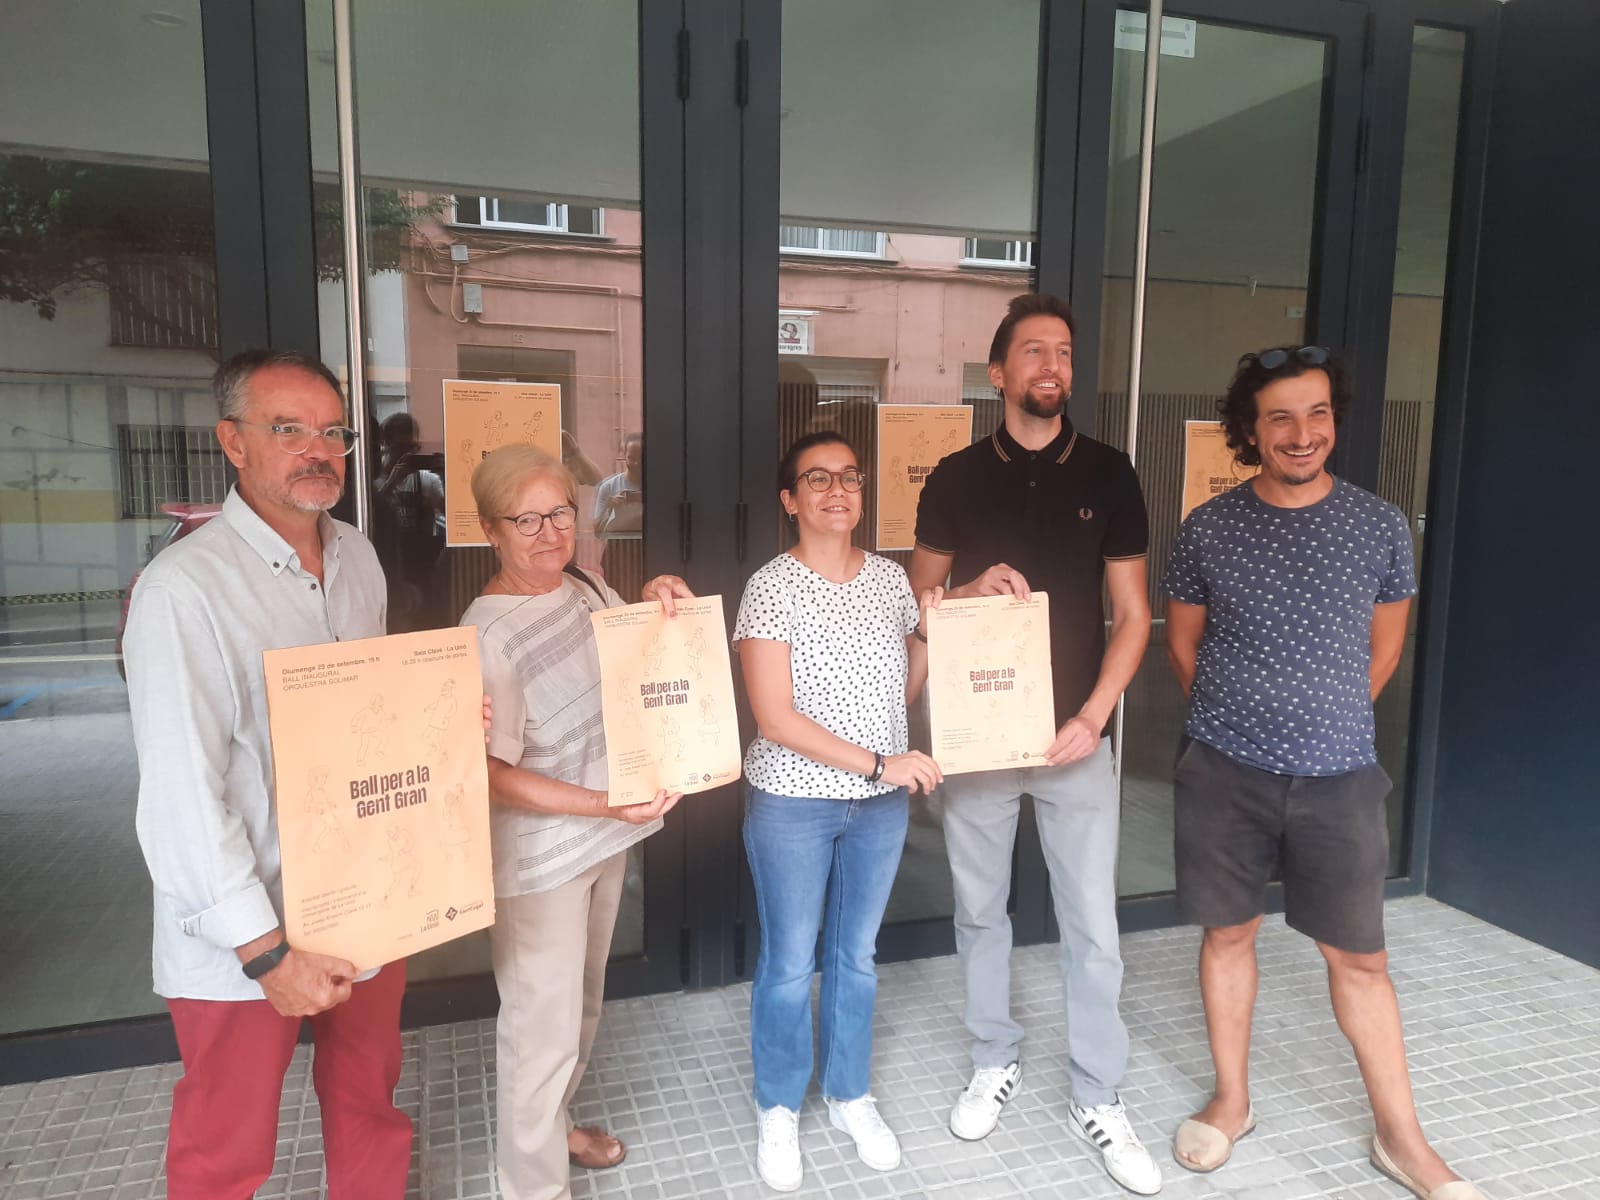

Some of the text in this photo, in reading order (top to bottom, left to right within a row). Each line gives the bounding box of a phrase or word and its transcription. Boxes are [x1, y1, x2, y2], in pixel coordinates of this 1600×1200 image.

[908, 465, 919, 474] Ball
[920, 466, 930, 475] per
[282, 665, 316, 675] Diumenge
[970, 667, 1015, 681] Ball per a la
[282, 671, 340, 683] BALL INAUGURAL
[283, 679, 327, 691] ORQUESTRA
[641, 679, 690, 696] Ball per a la
[973, 680, 1013, 693] Gent Gran
[644, 693, 688, 709] Gent Gran
[350, 766, 430, 800] Ball per a la
[356, 787, 427, 818] Gent Gran
